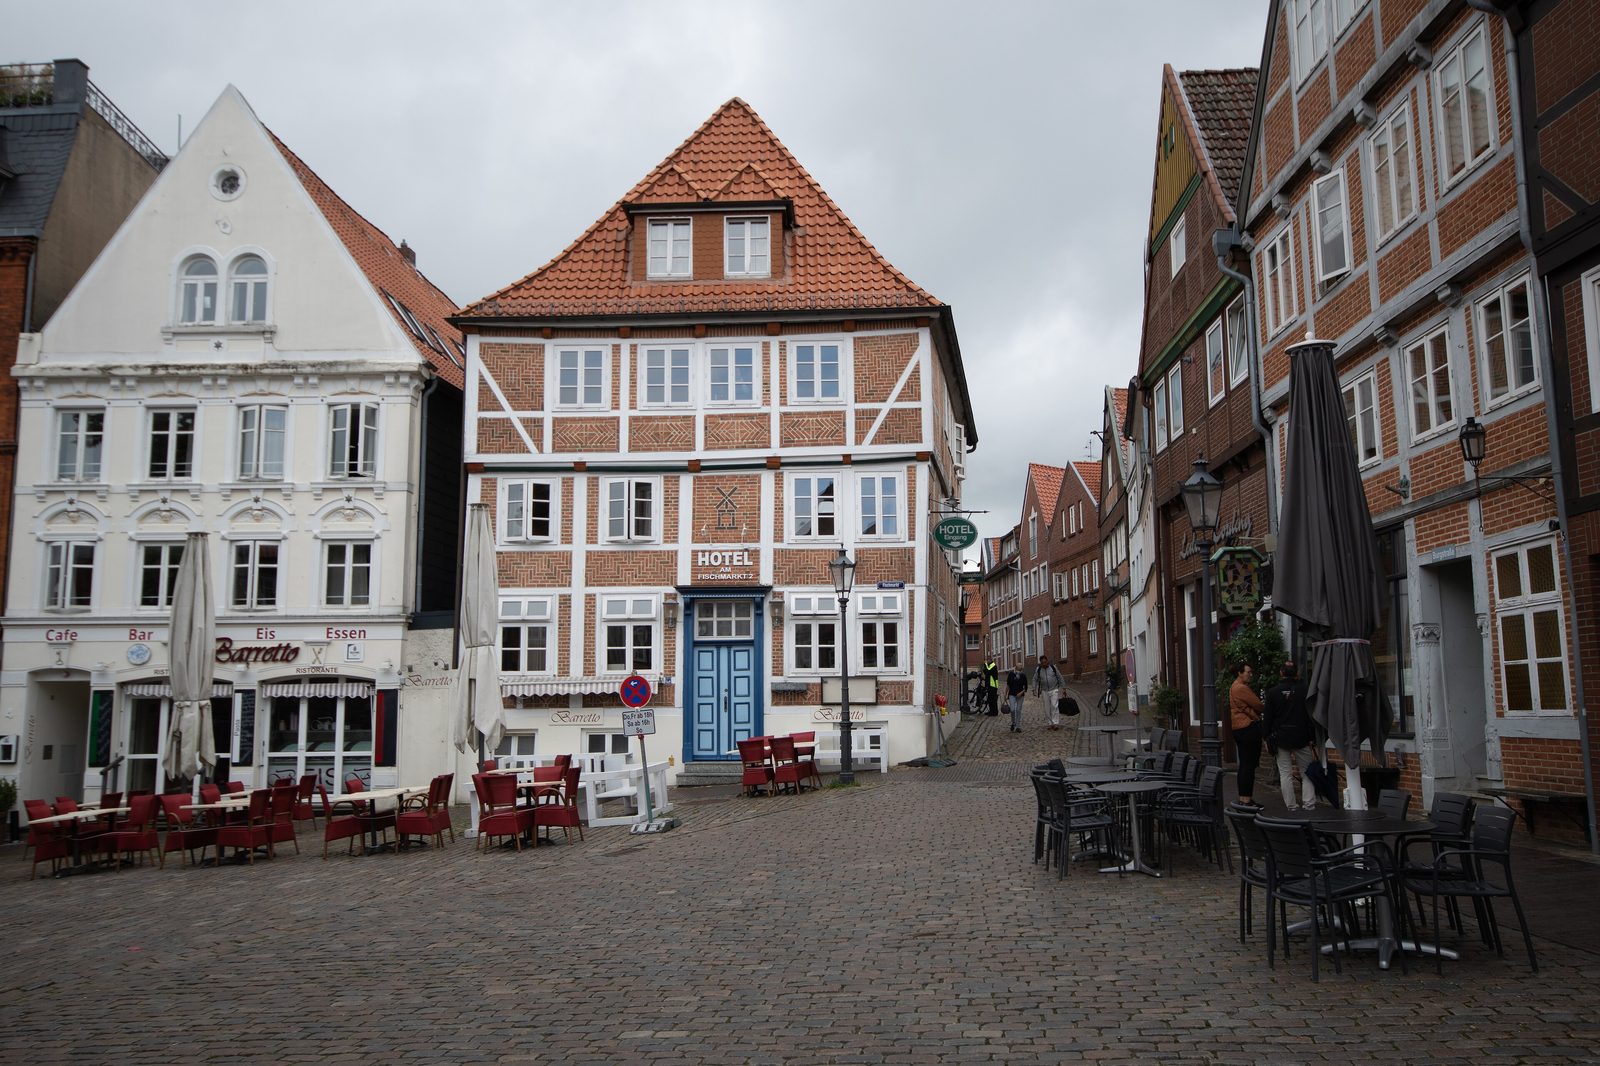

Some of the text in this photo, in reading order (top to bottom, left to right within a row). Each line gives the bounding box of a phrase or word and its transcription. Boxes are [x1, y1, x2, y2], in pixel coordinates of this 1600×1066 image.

[939, 525, 974, 535] HOTEL
[698, 551, 754, 567] HOTEL
[46, 629, 78, 641] Cafe
[129, 628, 154, 641] Bar
[256, 627, 275, 640] Eis
[326, 627, 367, 639] Essen
[296, 666, 339, 674] RISTORANTE
[551, 710, 601, 723] Barretto
